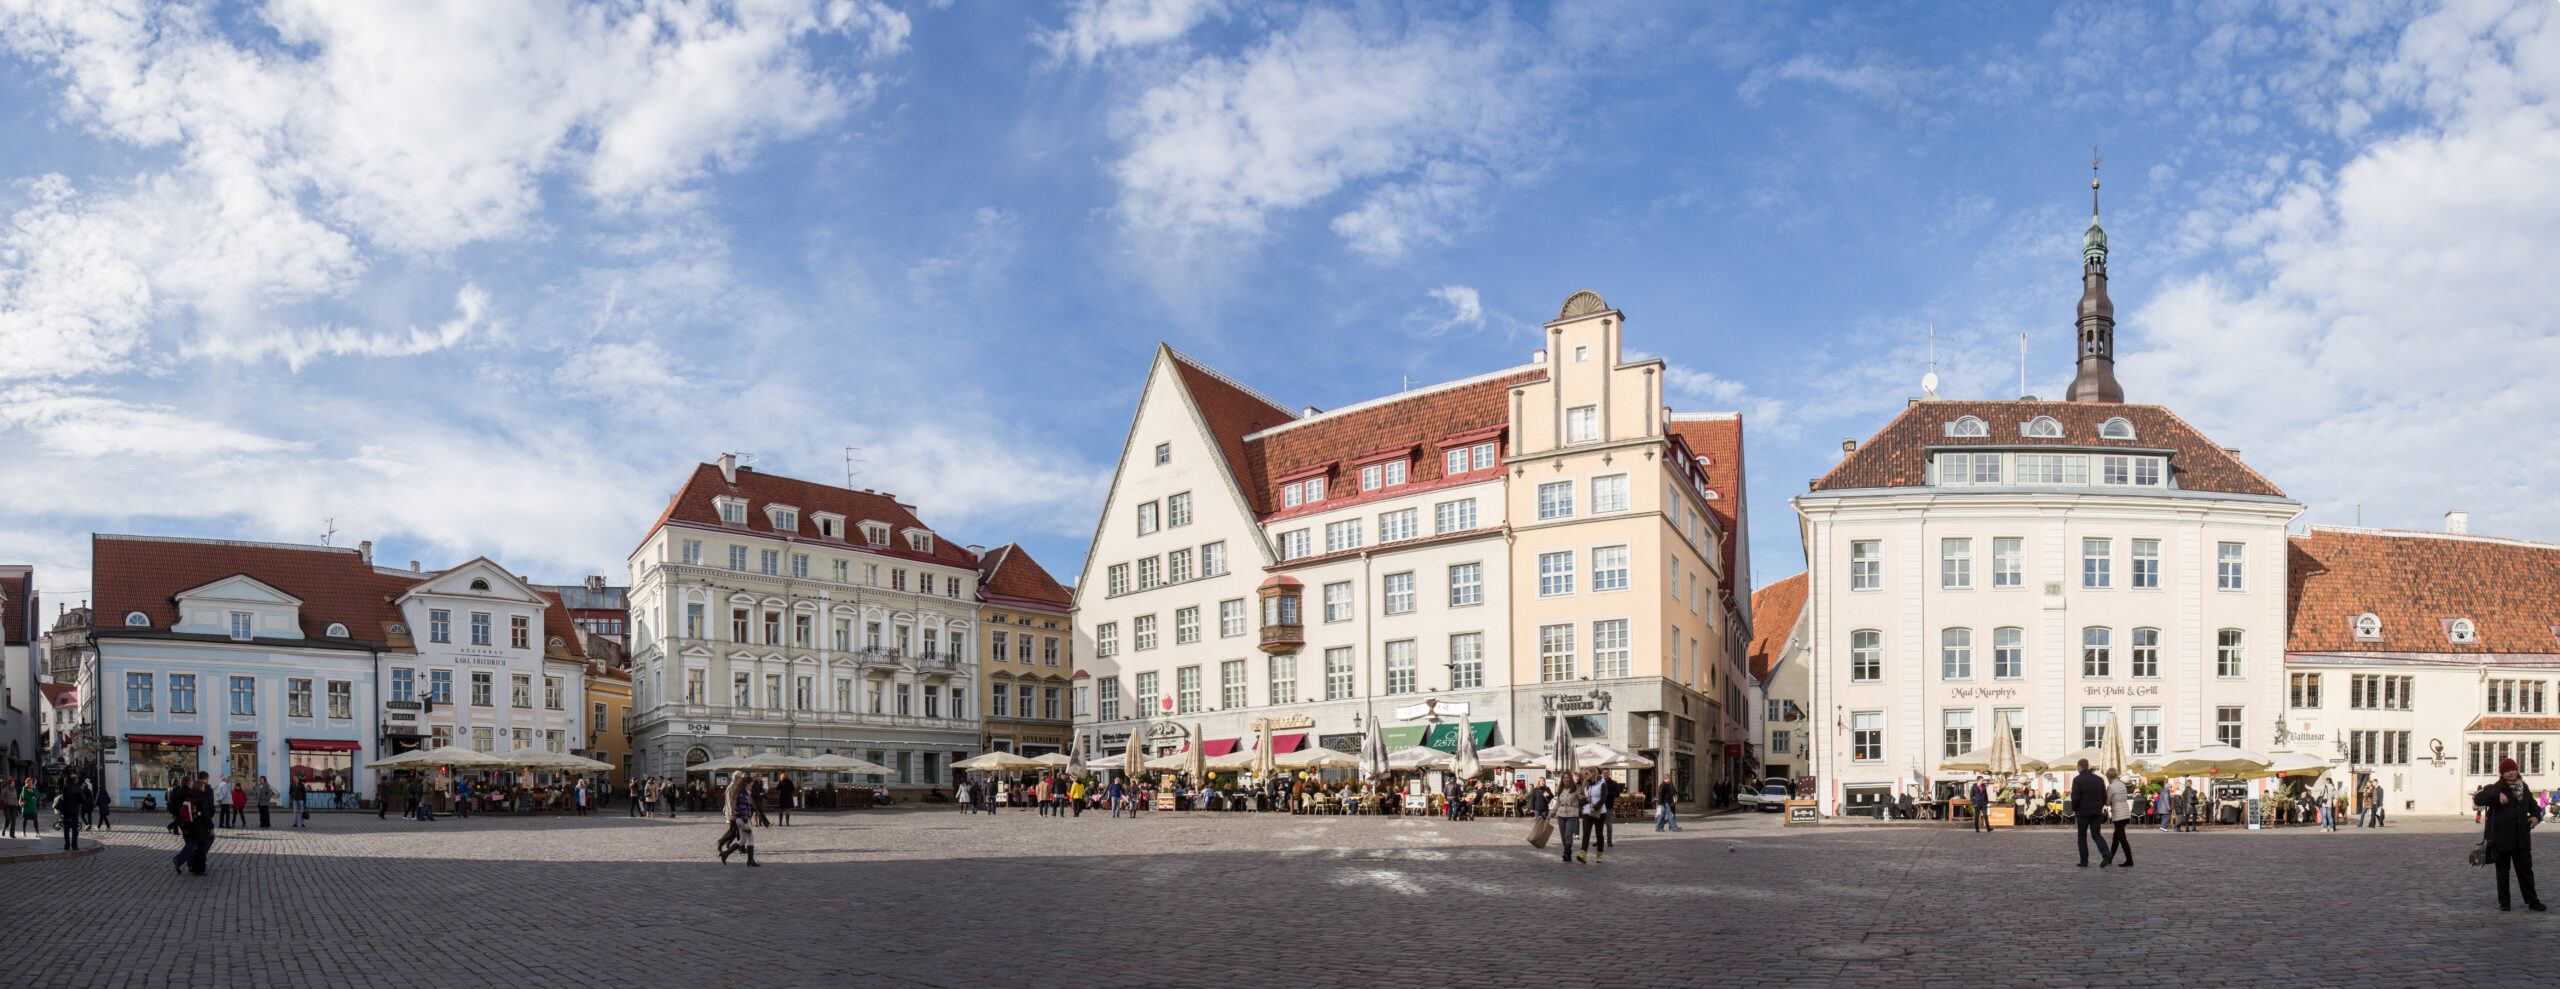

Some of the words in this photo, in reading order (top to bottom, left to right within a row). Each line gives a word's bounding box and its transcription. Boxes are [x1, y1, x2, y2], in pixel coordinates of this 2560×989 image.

[473, 658, 506, 666] FRIEDRICH
[1952, 687, 1973, 699] Mad
[1975, 687, 2017, 699] Murphy's
[2103, 686, 2125, 698] Pubi
[2127, 686, 2135, 696] &
[2136, 685, 2159, 697] Grill
[229, 730, 259, 739] ESPRIT
[1022, 735, 1060, 743] SUVENIIRID
[2290, 731, 2325, 741] Balthasar
